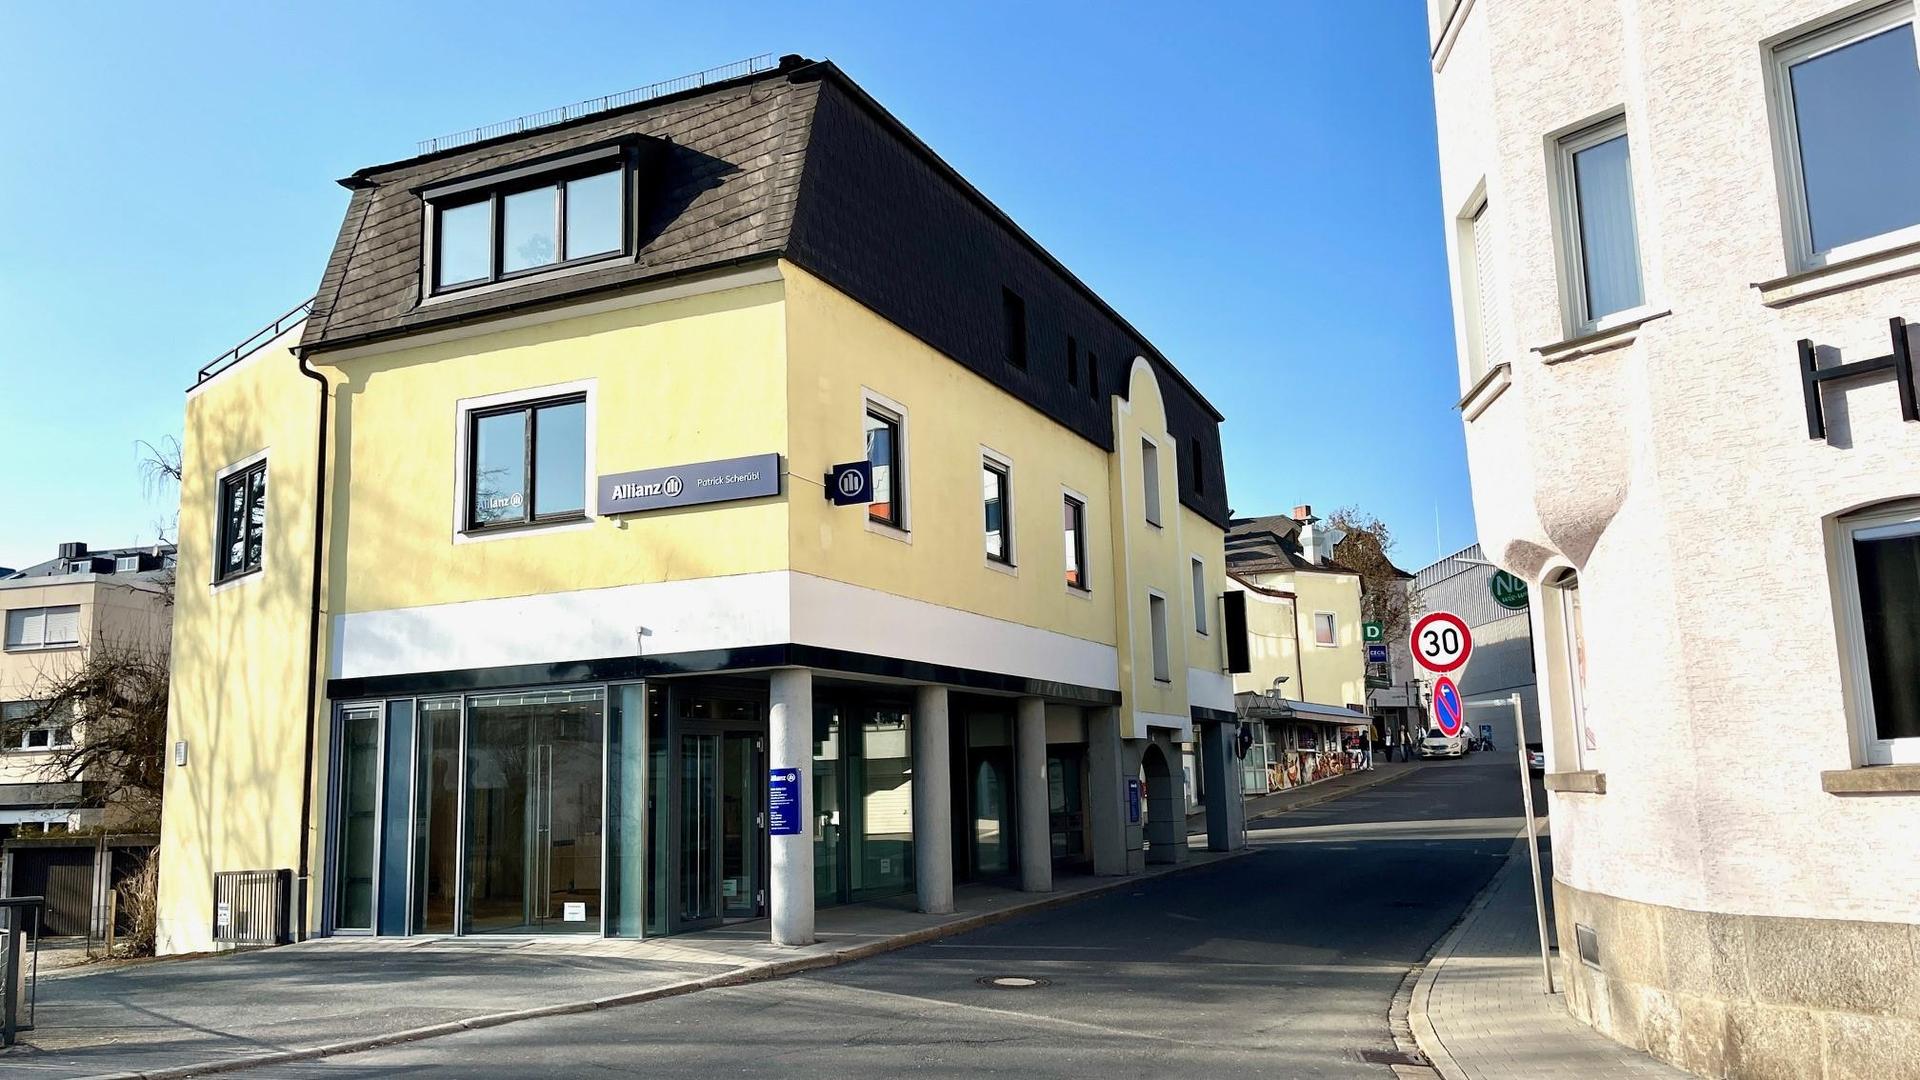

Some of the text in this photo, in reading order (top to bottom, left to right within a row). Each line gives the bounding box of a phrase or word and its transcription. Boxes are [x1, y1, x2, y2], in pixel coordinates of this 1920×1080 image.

[612, 471, 760, 500] Allianz Patrick Scherübl
[1366, 626, 1380, 638] D
[1423, 628, 1459, 657] 30
